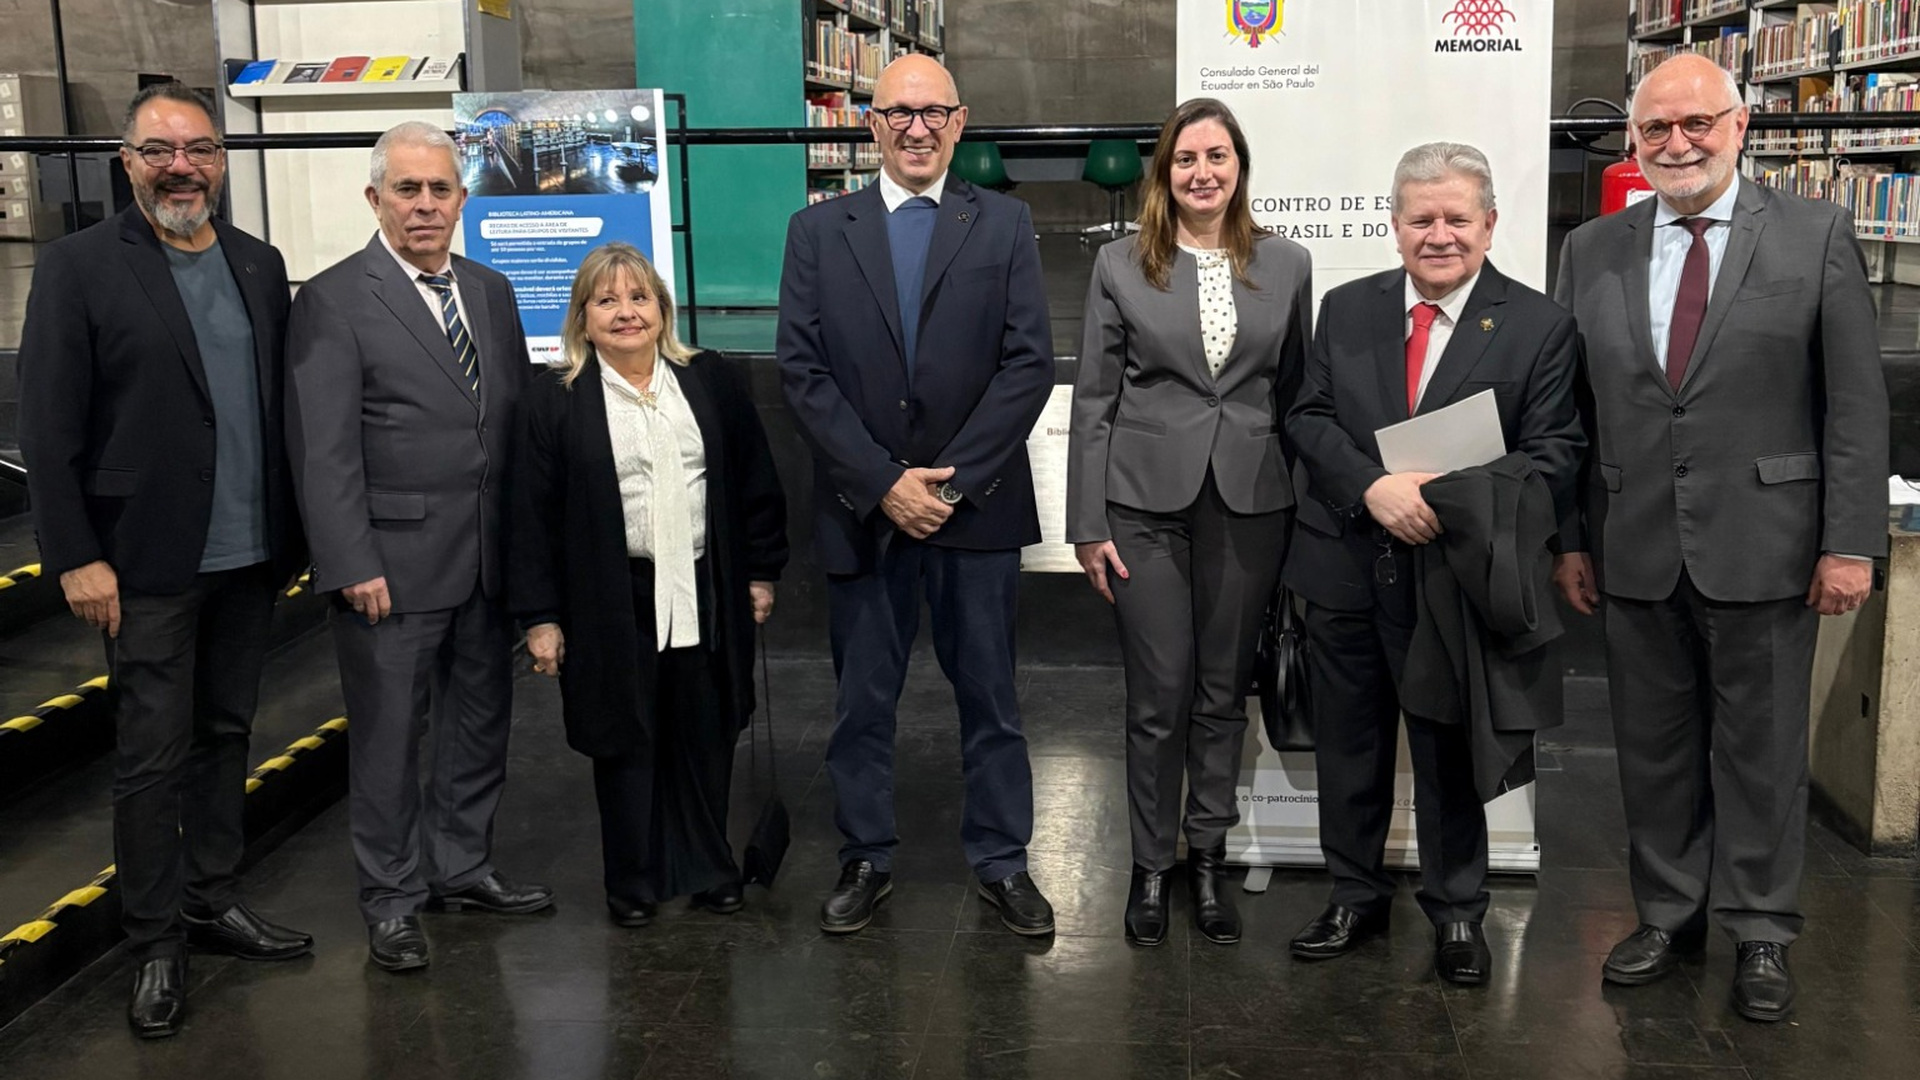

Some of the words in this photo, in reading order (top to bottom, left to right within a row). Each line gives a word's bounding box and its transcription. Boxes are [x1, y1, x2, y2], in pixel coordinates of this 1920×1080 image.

[1434, 38, 1522, 52] MEMORIAL
[1200, 66, 1256, 77] Consulado
[1258, 65, 1300, 76] General
[1303, 64, 1320, 75] del
[1201, 80, 1244, 90] Ecuador
[1262, 79, 1283, 89] São
[1286, 78, 1315, 88] Paulo
[1340, 196, 1365, 210] DE
[1342, 224, 1352, 238] E
[1362, 223, 1388, 237] DO
[1252, 794, 1319, 804] co-patrocínio
